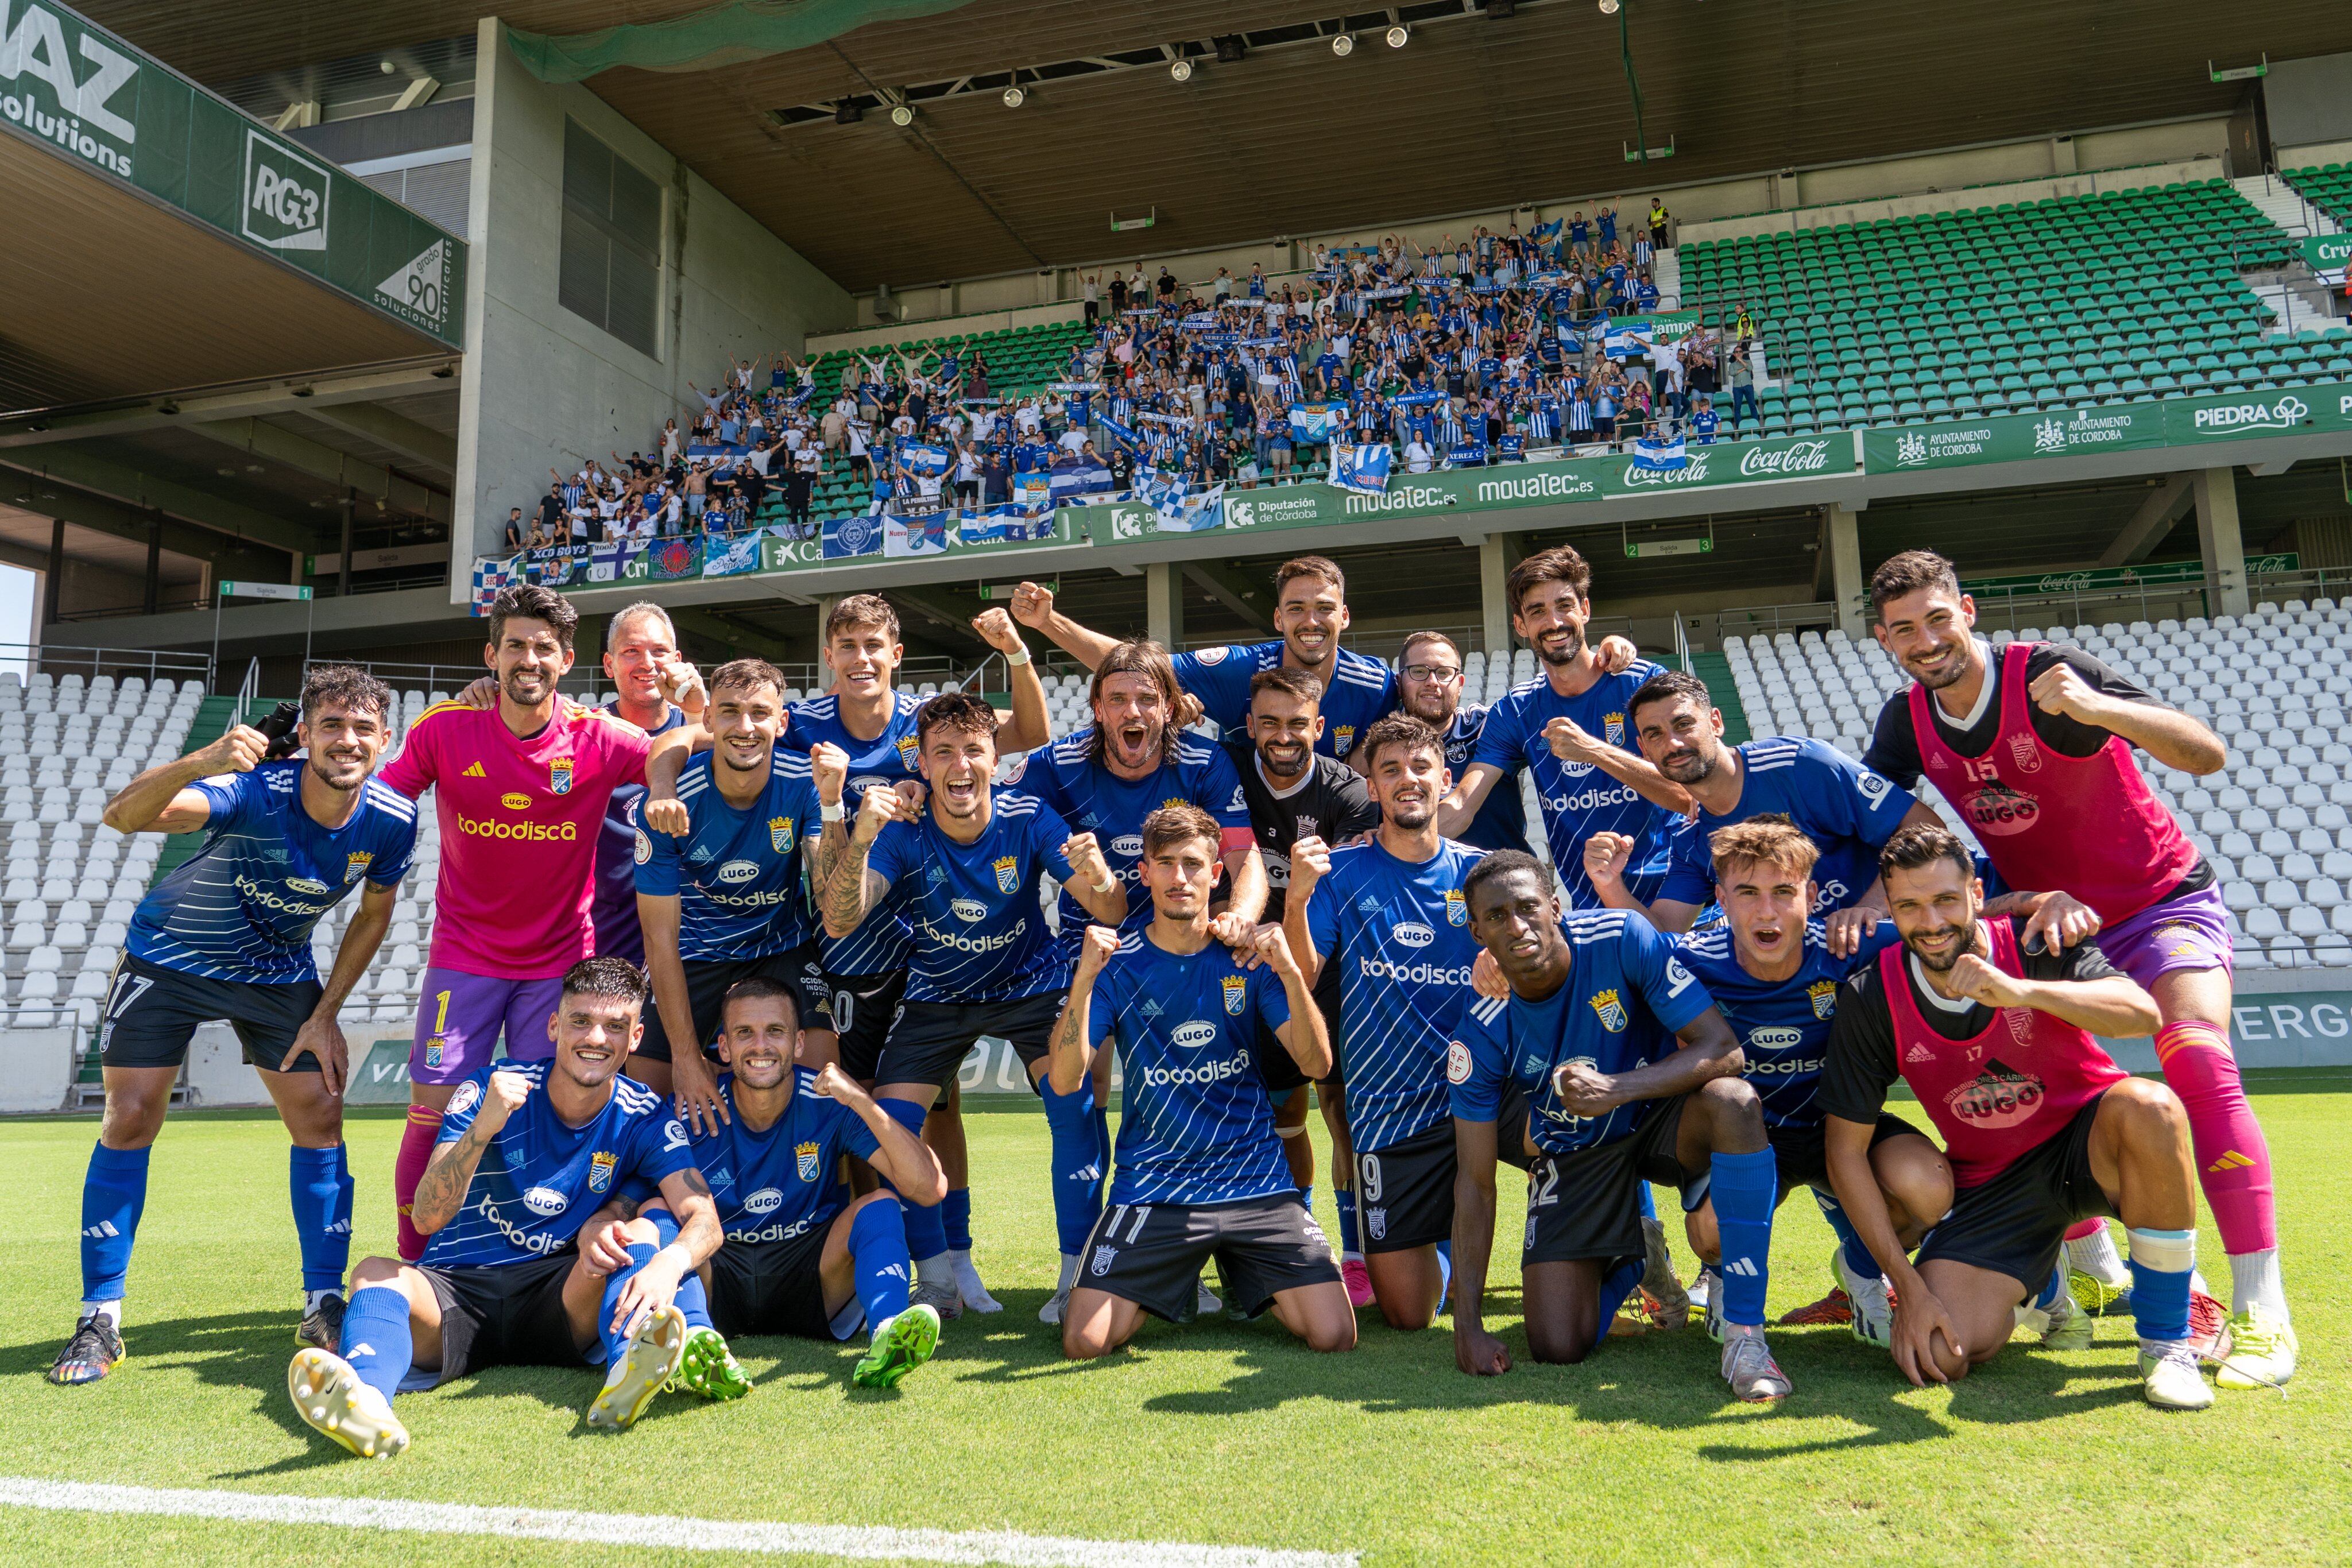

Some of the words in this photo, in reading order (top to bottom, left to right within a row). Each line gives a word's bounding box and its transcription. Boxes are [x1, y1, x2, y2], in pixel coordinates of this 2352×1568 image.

[252, 164, 319, 230] RG3
[416, 248, 440, 274] grado
[441, 240, 452, 324] verticales
[408, 274, 440, 318] 90
[374, 293, 441, 333] soluciones
[2068, 416, 2131, 431] AYUNTAMIENTO
[1930, 429, 1991, 445] AYUNTAMIENTO
[2068, 433, 2079, 444] DE
[1740, 440, 1828, 476] Coca-Cola
[1931, 447, 1941, 458] DE
[1258, 498, 1316, 512] Diputación
[1260, 513, 1273, 523] de
[1275, 509, 1317, 521] Córdoba
[532, 549, 556, 559] XCD
[556, 544, 587, 557] BOYS
[1628, 545, 1637, 556] 2
[1702, 540, 1709, 551] 3
[226, 583, 231, 593] 1
[302, 588, 308, 598] 1
[984, 588, 989, 598] 1
[1565, 761, 1594, 773] LUGO
[1963, 757, 1999, 781] 15
[1079, 820, 1102, 828] adidas
[1268, 827, 1276, 837] 3
[264, 849, 288, 865] adidas
[721, 868, 757, 880] LUGO
[926, 874, 949, 882] adidas
[288, 879, 323, 895] LUGO
[953, 905, 986, 917] LUGO
[1397, 930, 1432, 942] LUGO
[106, 972, 154, 1019] 17
[435, 990, 452, 1033] 1
[1139, 1008, 1165, 1016] adidas
[1175, 1028, 1215, 1043] LUGO
[1755, 1033, 1800, 1044] LUGO
[1906, 1052, 1936, 1063] adidas
[1966, 1045, 1982, 1062] 17
[1525, 1062, 1550, 1075] adidas
[1943, 1074, 1998, 1104] DISTRIBUCIONES
[1962, 1086, 2040, 1119] LUGO
[505, 1155, 527, 1170] adidas
[709, 1178, 735, 1186] adidas
[1363, 1153, 1382, 1202] 9
[526, 1195, 565, 1211] LUGO
[748, 1197, 780, 1209] LUGO
